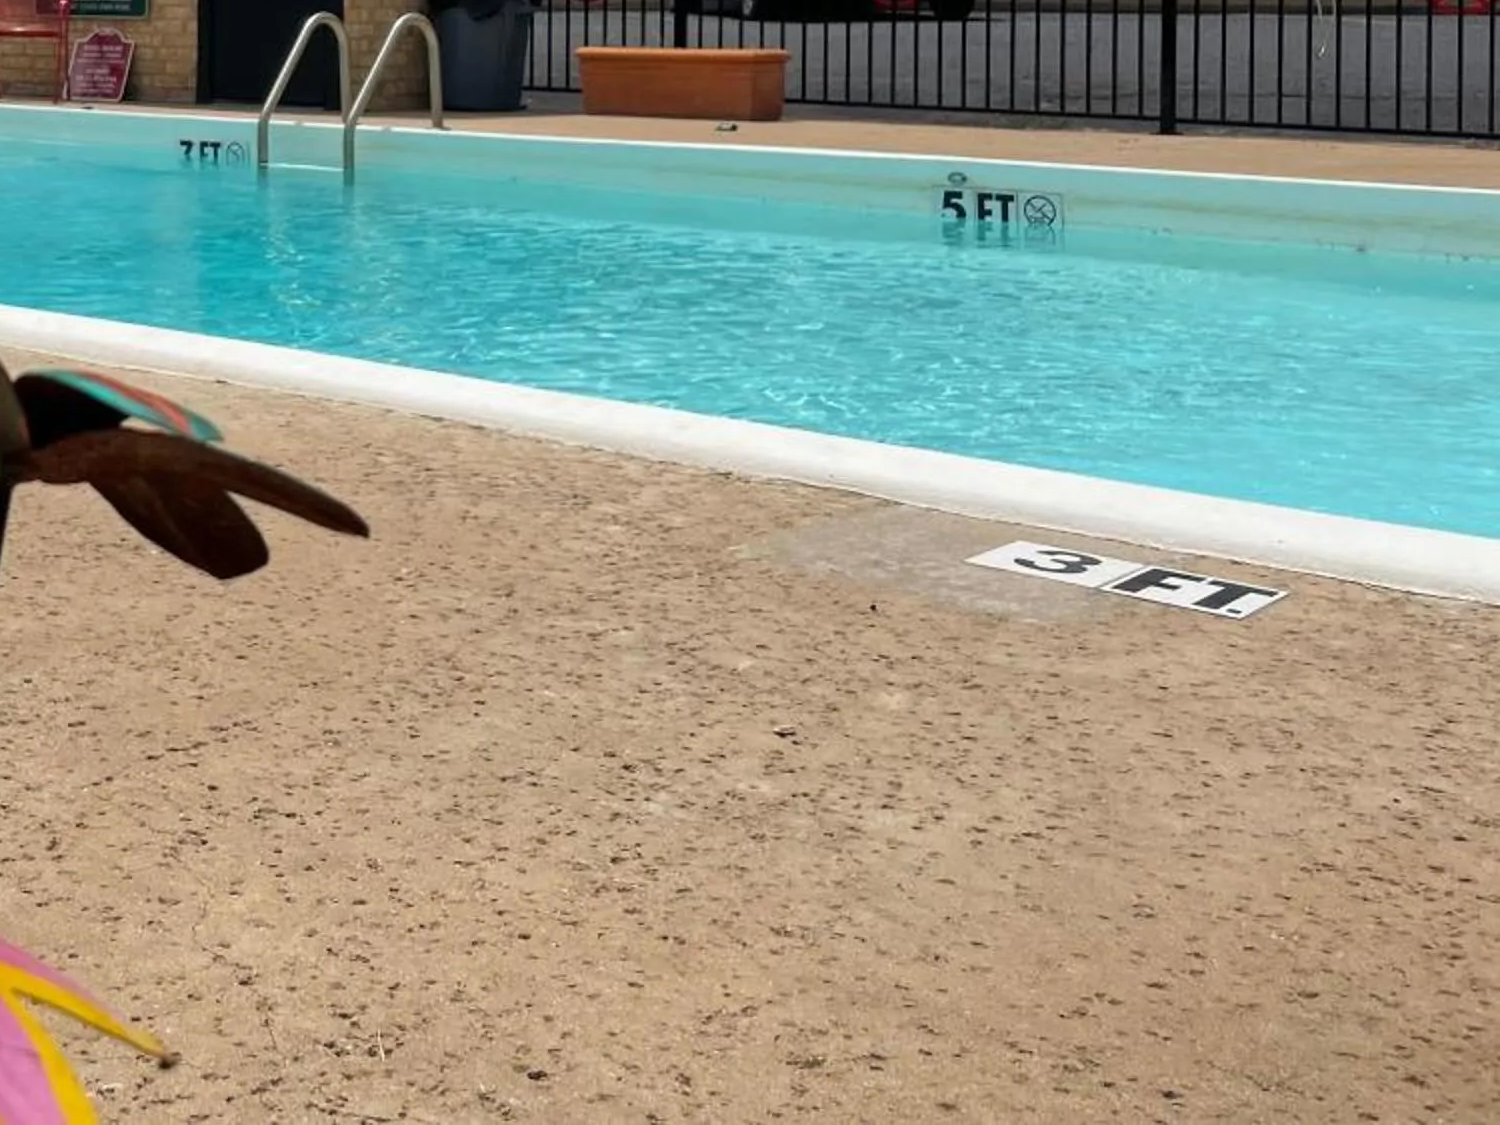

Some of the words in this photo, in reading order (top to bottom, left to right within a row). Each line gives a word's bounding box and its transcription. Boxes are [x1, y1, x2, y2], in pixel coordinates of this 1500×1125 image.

[180, 140, 194, 157] 7
[200, 141, 221, 159] FT
[941, 190, 967, 219] 5
[977, 192, 1014, 222] FT
[1013, 550, 1103, 575] 3
